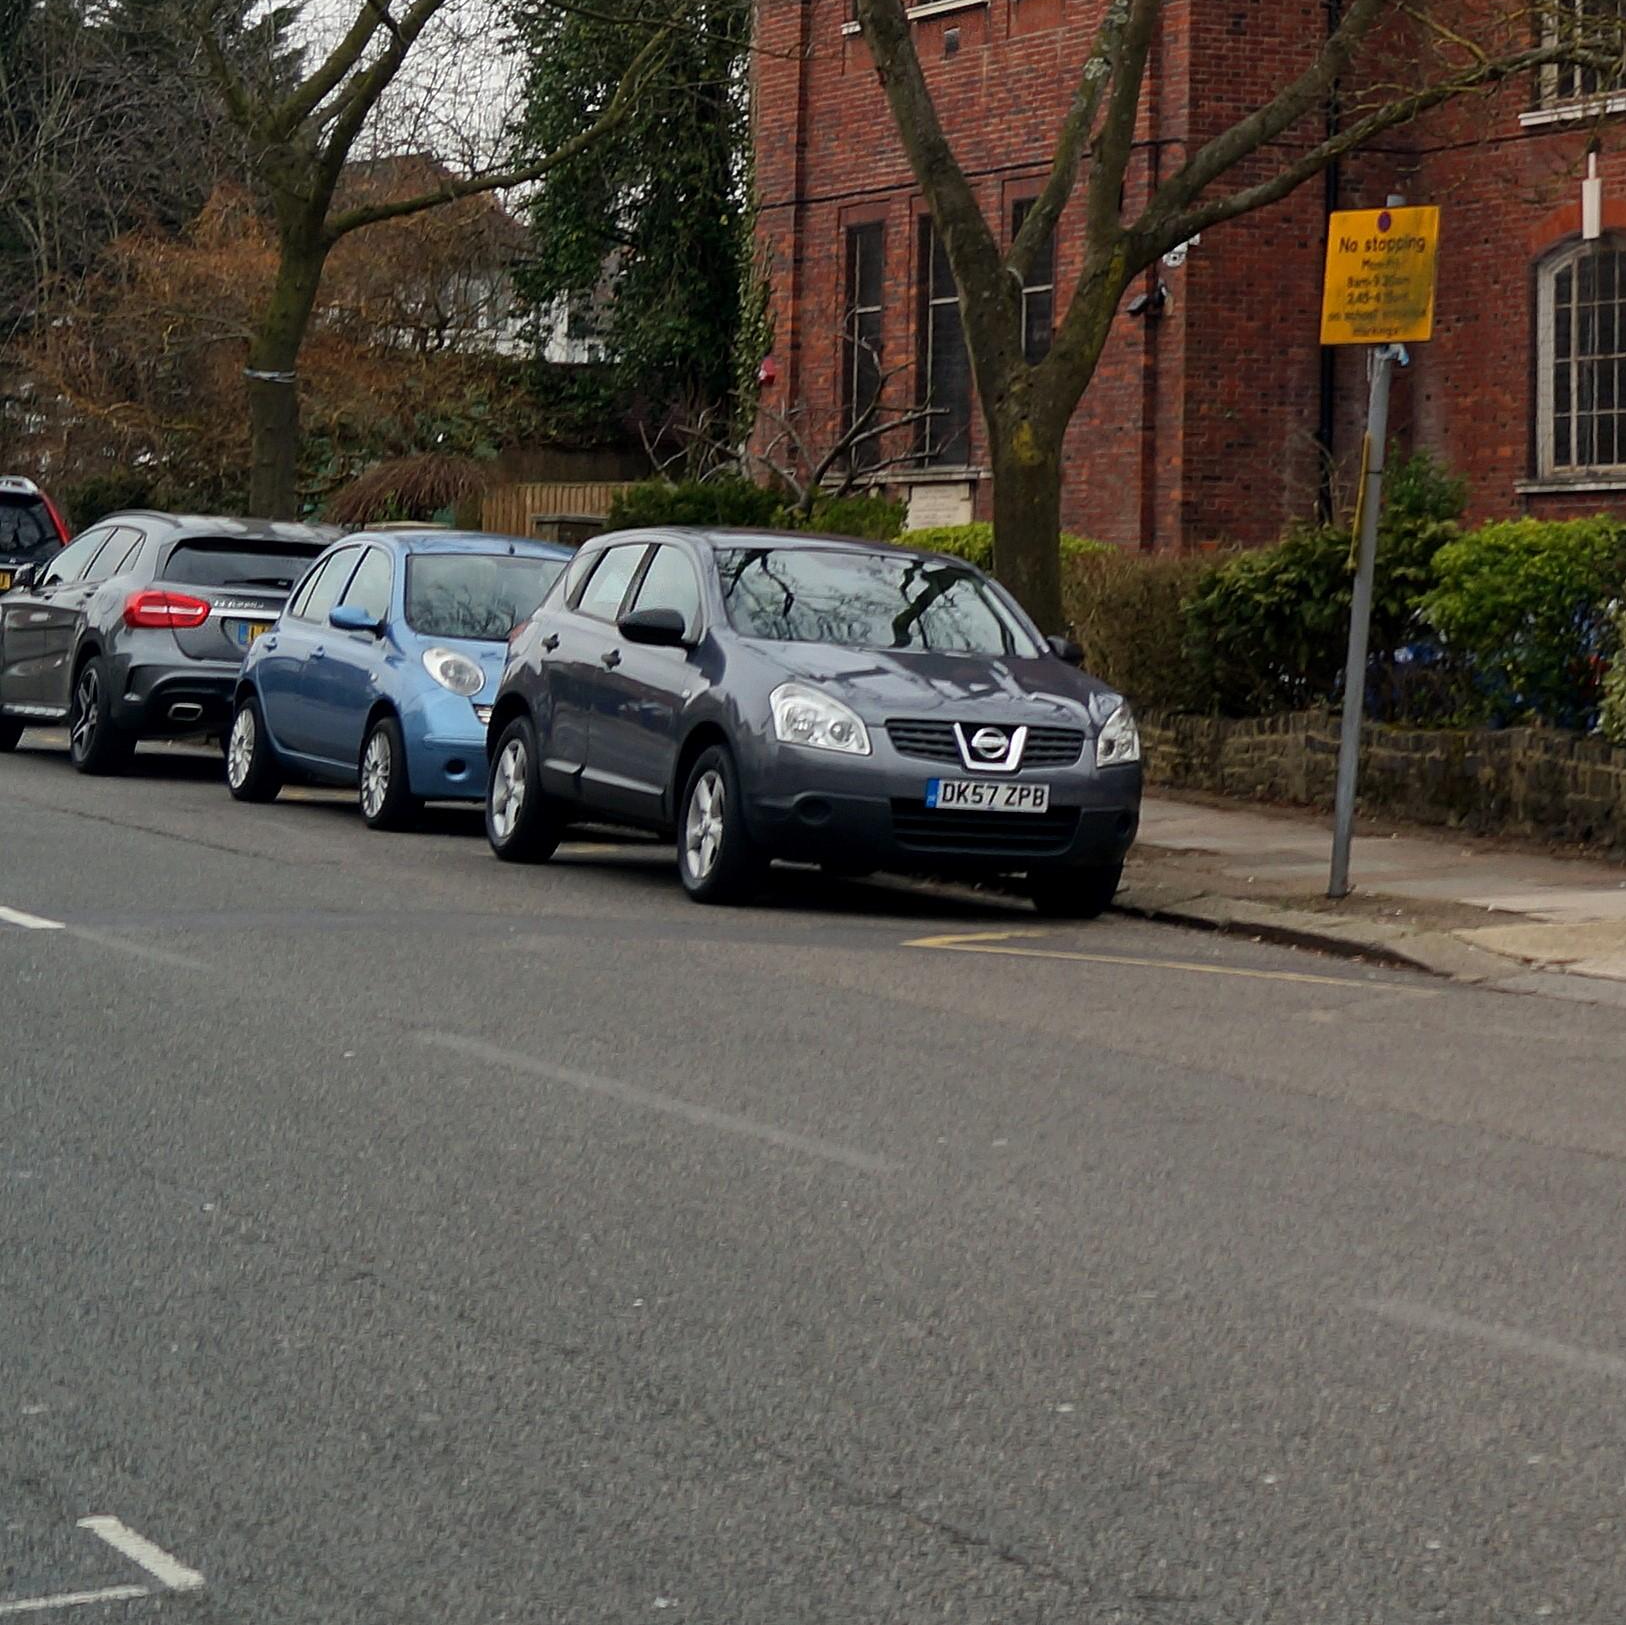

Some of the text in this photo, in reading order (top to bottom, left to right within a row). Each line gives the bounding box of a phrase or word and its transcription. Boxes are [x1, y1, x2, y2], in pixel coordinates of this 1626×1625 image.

[1339, 236, 1425, 254] No stopping
[942, 782, 999, 806] DK57
[1004, 785, 1045, 807] ZPB
